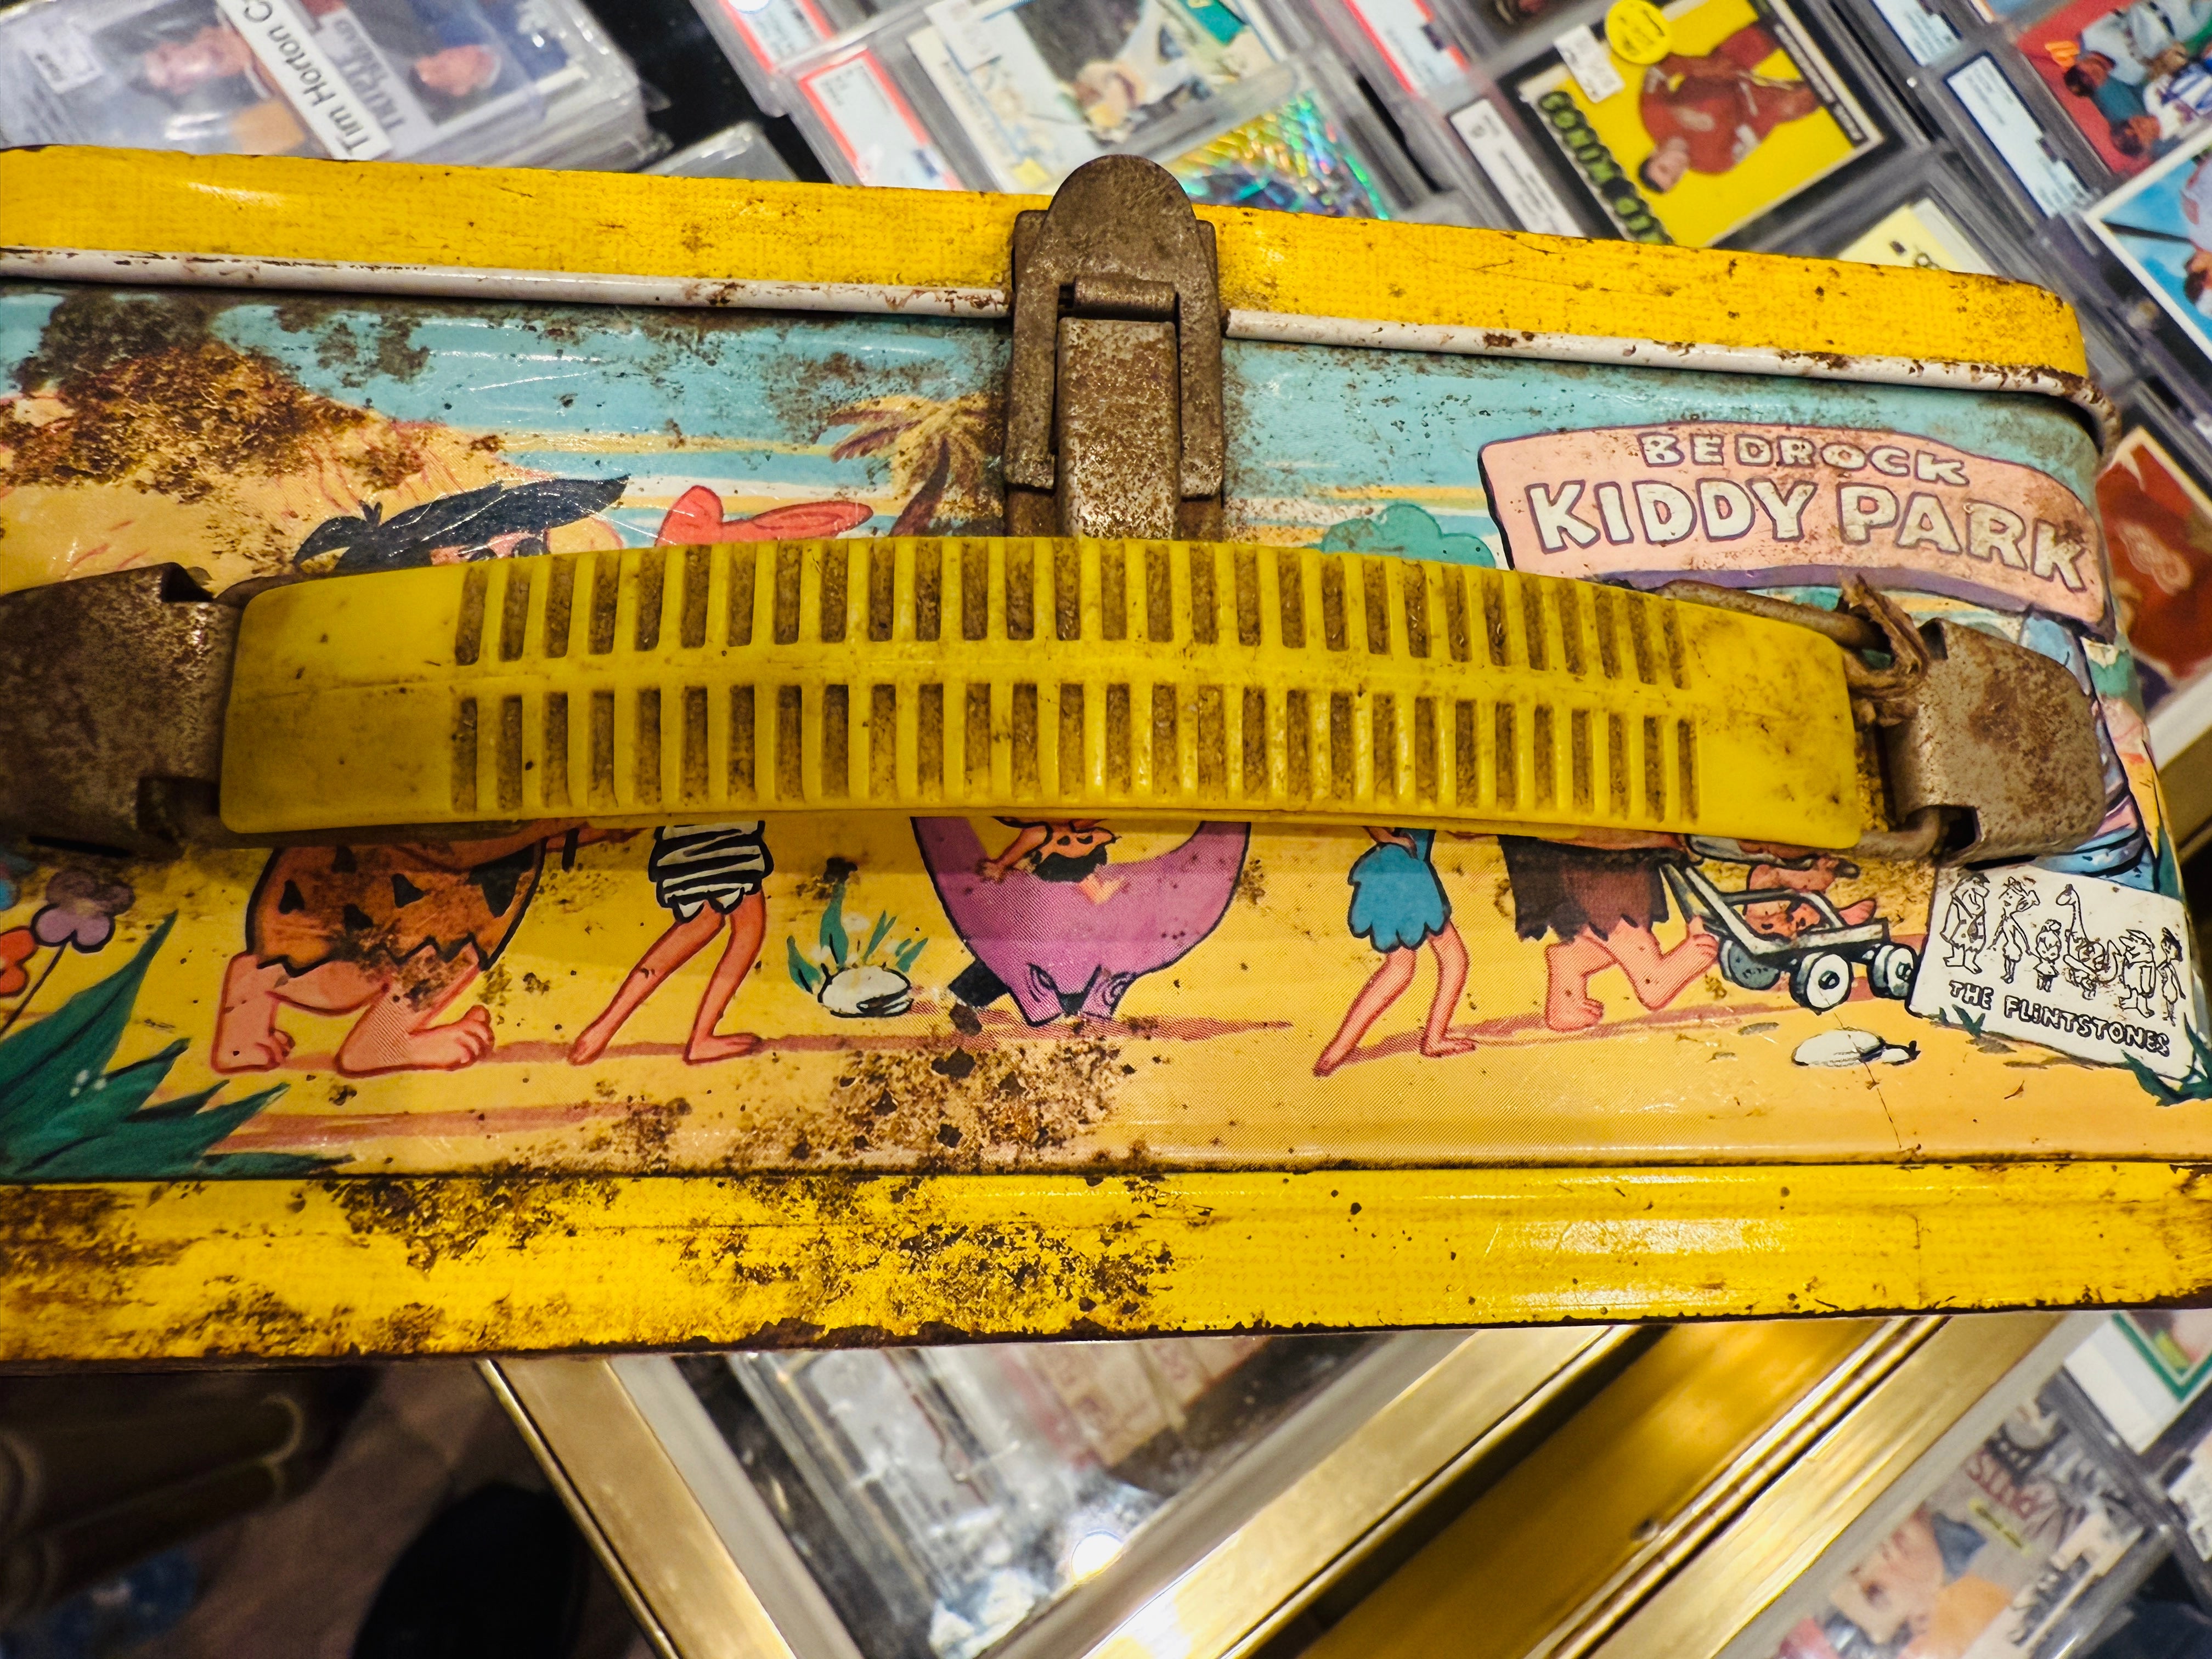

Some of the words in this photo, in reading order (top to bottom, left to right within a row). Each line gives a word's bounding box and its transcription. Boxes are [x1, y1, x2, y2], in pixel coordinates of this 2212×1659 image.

[242, 0, 273, 23] C
[267, 25, 336, 106] Horton
[329, 104, 371, 152] Tim
[1637, 432, 1971, 488] BEDROCK
[1526, 477, 1818, 555] KIDDY
[1836, 481, 2090, 592] PARK
[1949, 979, 1994, 1011] THE
